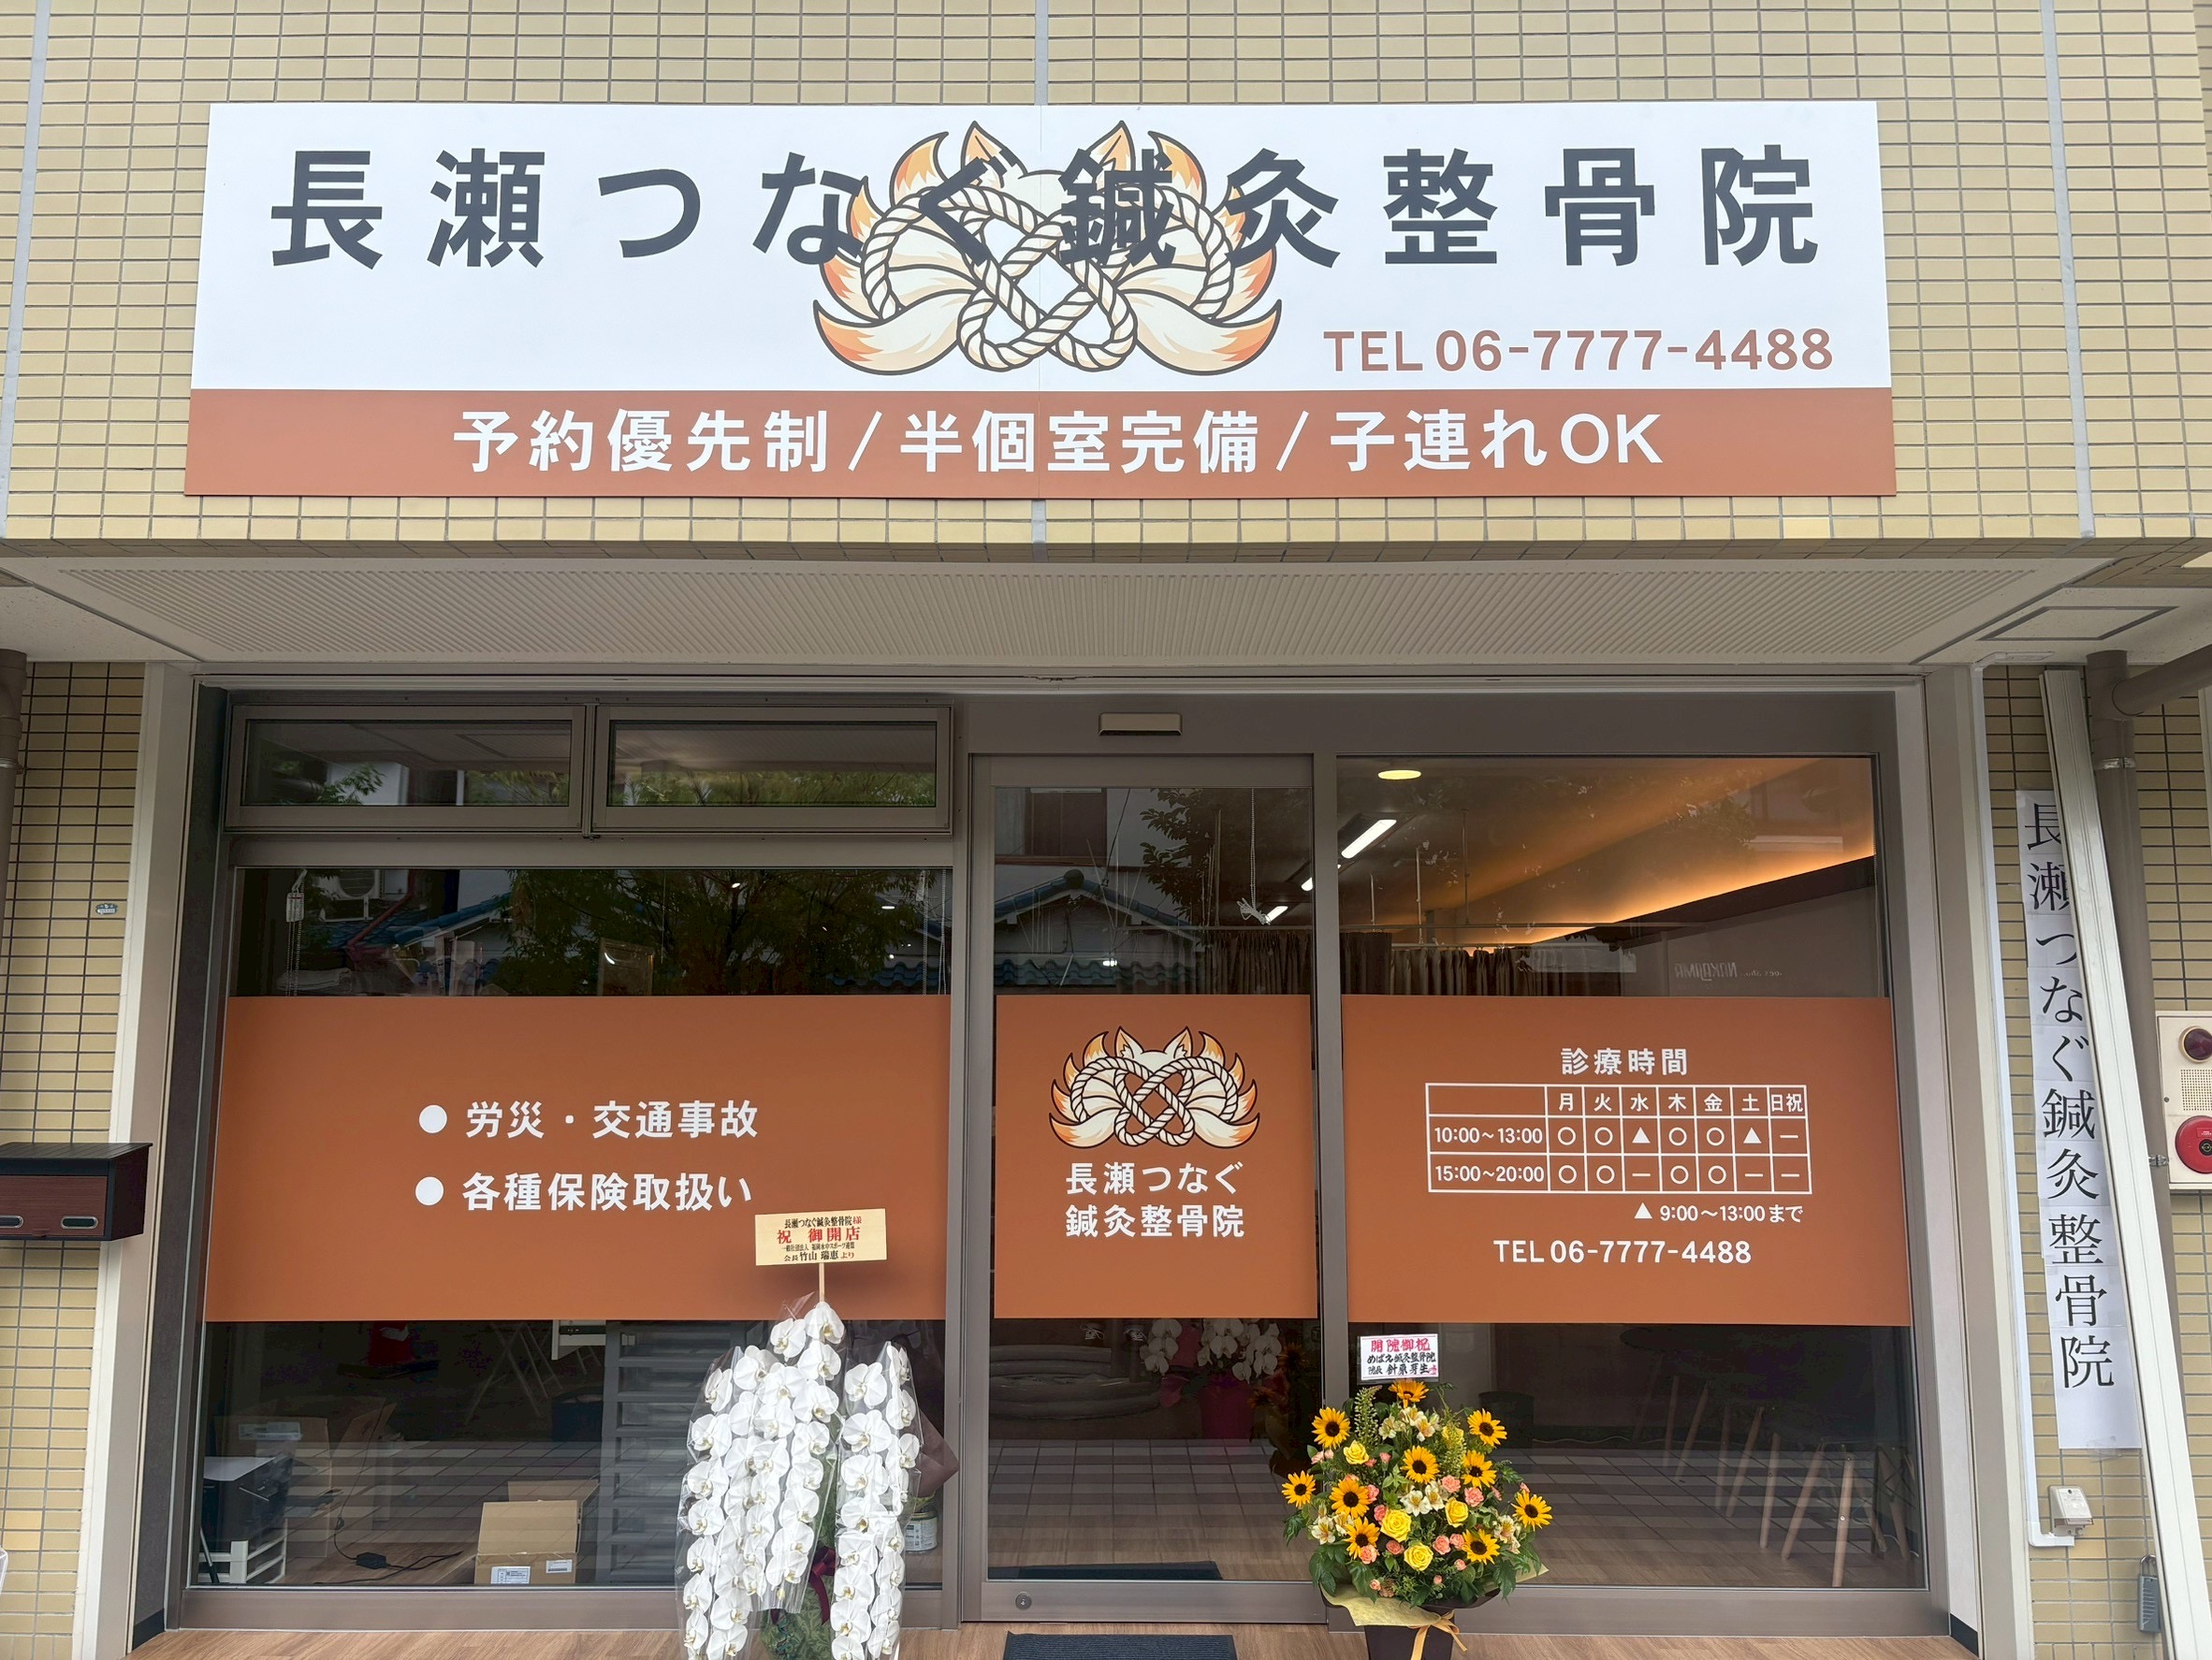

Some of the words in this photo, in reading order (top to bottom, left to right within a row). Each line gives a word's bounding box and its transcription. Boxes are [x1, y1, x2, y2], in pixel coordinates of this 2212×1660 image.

[269, 144, 1820, 269] 長瀬つなぐ鍼灸整骨院
[1324, 330, 1423, 371] TEL
[1434, 328, 1834, 371] 06-7777-4488
[1561, 1047, 1689, 1076] 診療時間
[1558, 1093, 1575, 1113] 月
[1594, 1093, 1612, 1113] 火
[1630, 1093, 1650, 1113] 水
[1667, 1093, 1687, 1113] 木
[1703, 1093, 1724, 1113] 金
[1741, 1093, 1760, 1113] 土
[1770, 1093, 1804, 1113] 日祝
[462, 1172, 752, 1211] 各種保険取扱い
[1065, 1160, 1244, 1195] 長瀬つなぐ
[1065, 1203, 1244, 1238] 鍼灸整骨院
[1493, 1240, 1545, 1263] TEL
[1550, 1239, 1752, 1264] 06-7777-4488
